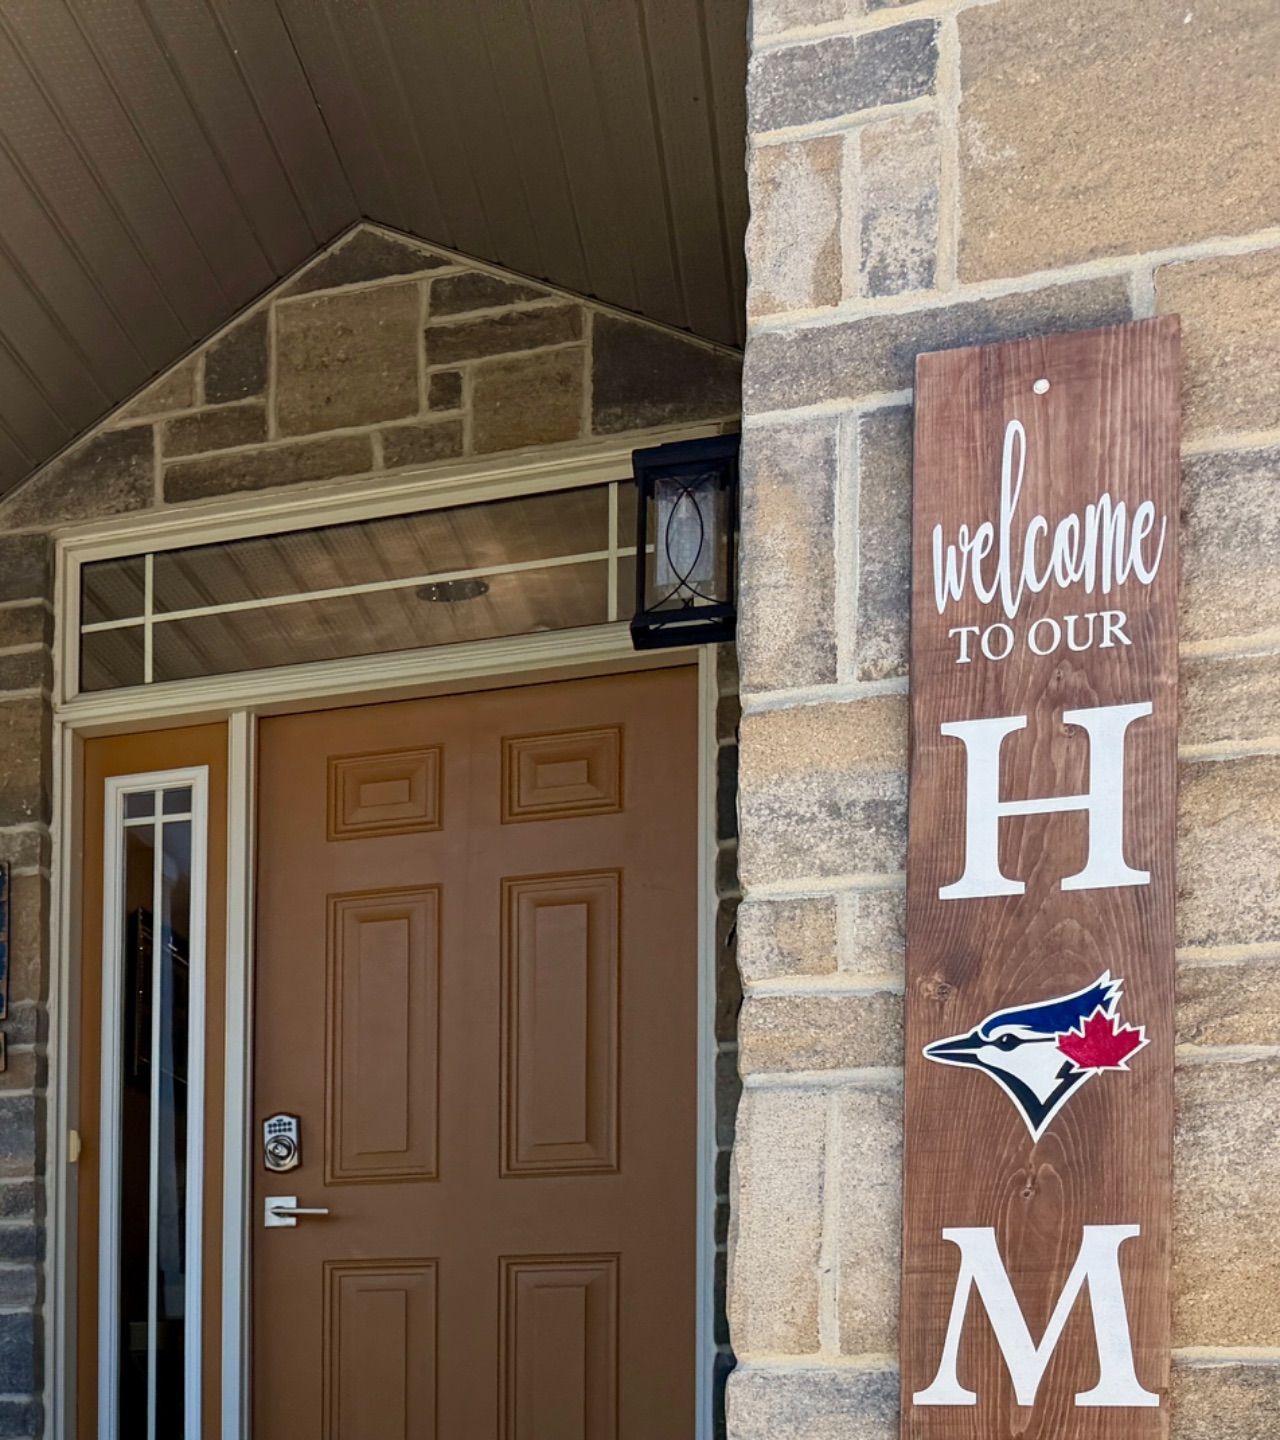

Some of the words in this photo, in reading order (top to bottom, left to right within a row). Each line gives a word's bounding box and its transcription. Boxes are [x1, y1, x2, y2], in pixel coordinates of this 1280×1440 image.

[932, 419, 1167, 619] welcome
[948, 622, 1015, 665] TO
[1027, 609, 1133, 657] OUR
